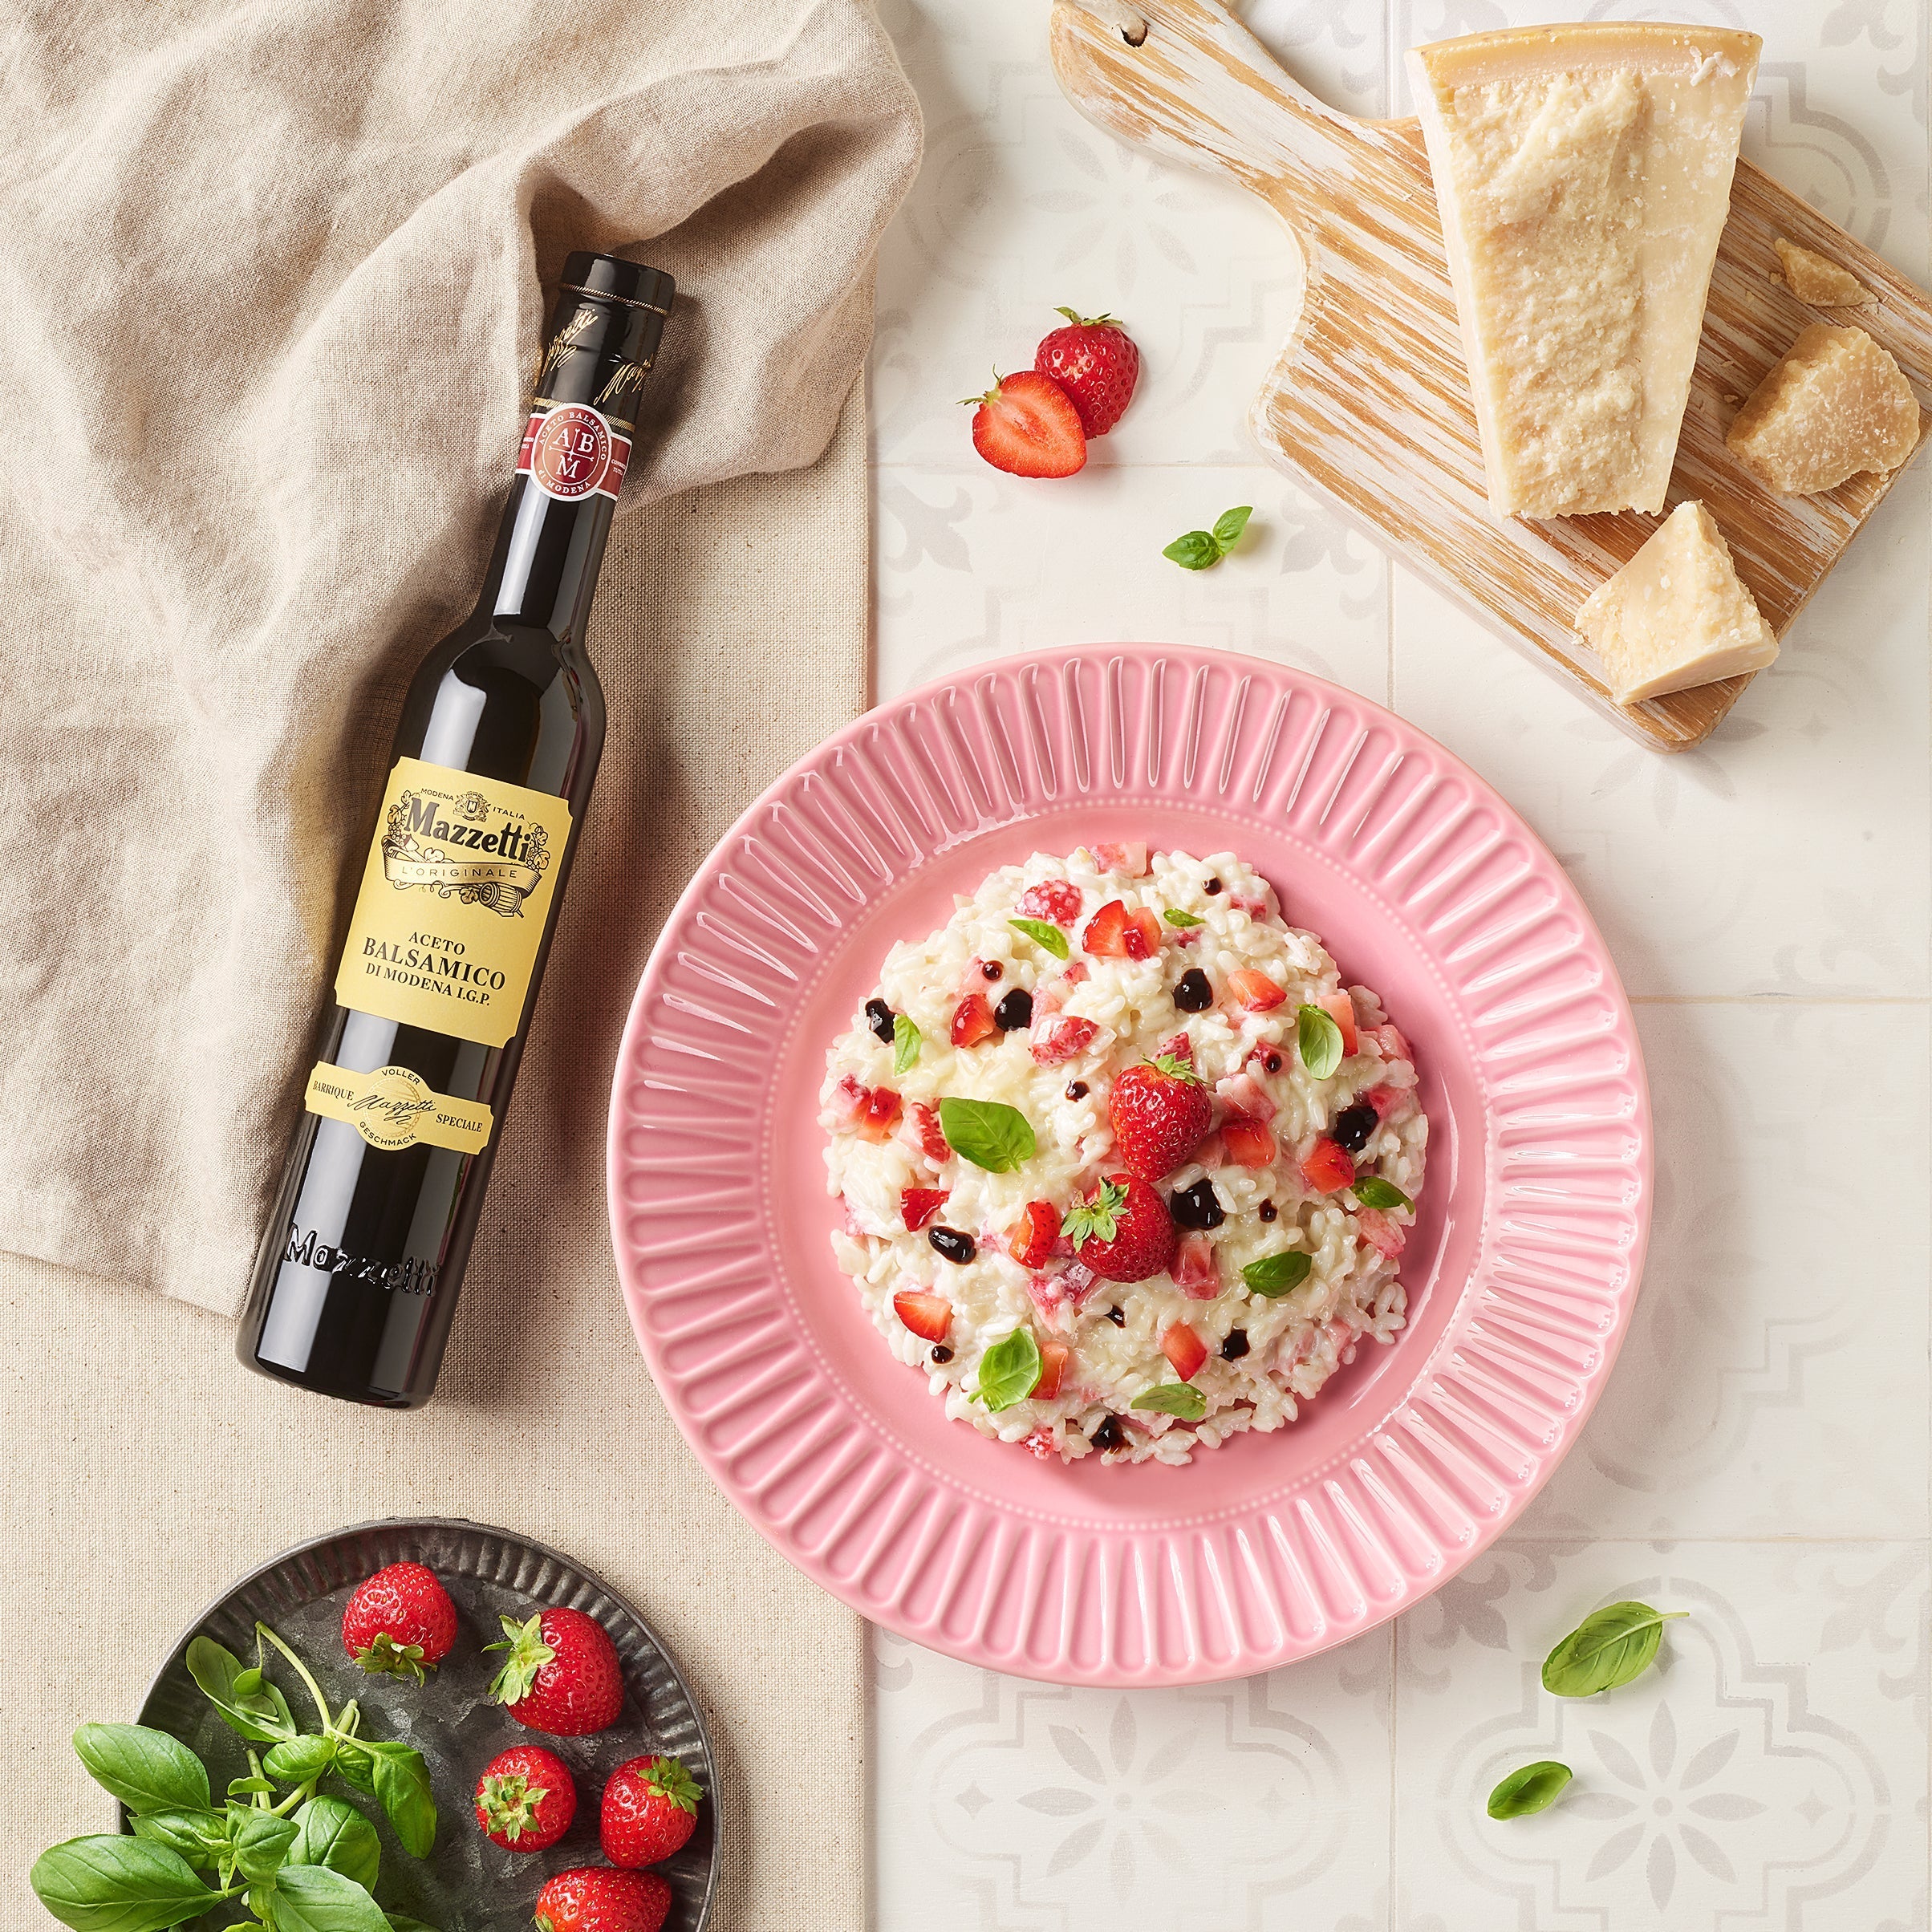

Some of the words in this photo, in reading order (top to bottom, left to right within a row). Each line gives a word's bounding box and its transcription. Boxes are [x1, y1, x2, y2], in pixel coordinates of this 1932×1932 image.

[539, 415, 564, 445] ACETO
[568, 412, 607, 461] BALSAMICO
[546, 481, 591, 494] MODENA
[420, 787, 454, 802] MODENA
[493, 806, 526, 821] ITALIA
[404, 797, 531, 863] Mazzetti
[402, 866, 518, 879] L'ORIGINALE
[408, 932, 465, 956] ACETO
[362, 936, 506, 990] BALSAMICO
[365, 962, 382, 977] DI
[383, 967, 453, 997] MODENA
[456, 986, 491, 1006] I.G.P.
[381, 1068, 420, 1086] VOLLER
[312, 1080, 355, 1102] BARRIQUE
[347, 1094, 437, 1125] Mazzetti
[359, 1120, 417, 1146] GESCHMACK
[436, 1113, 483, 1133] SPECIALE
